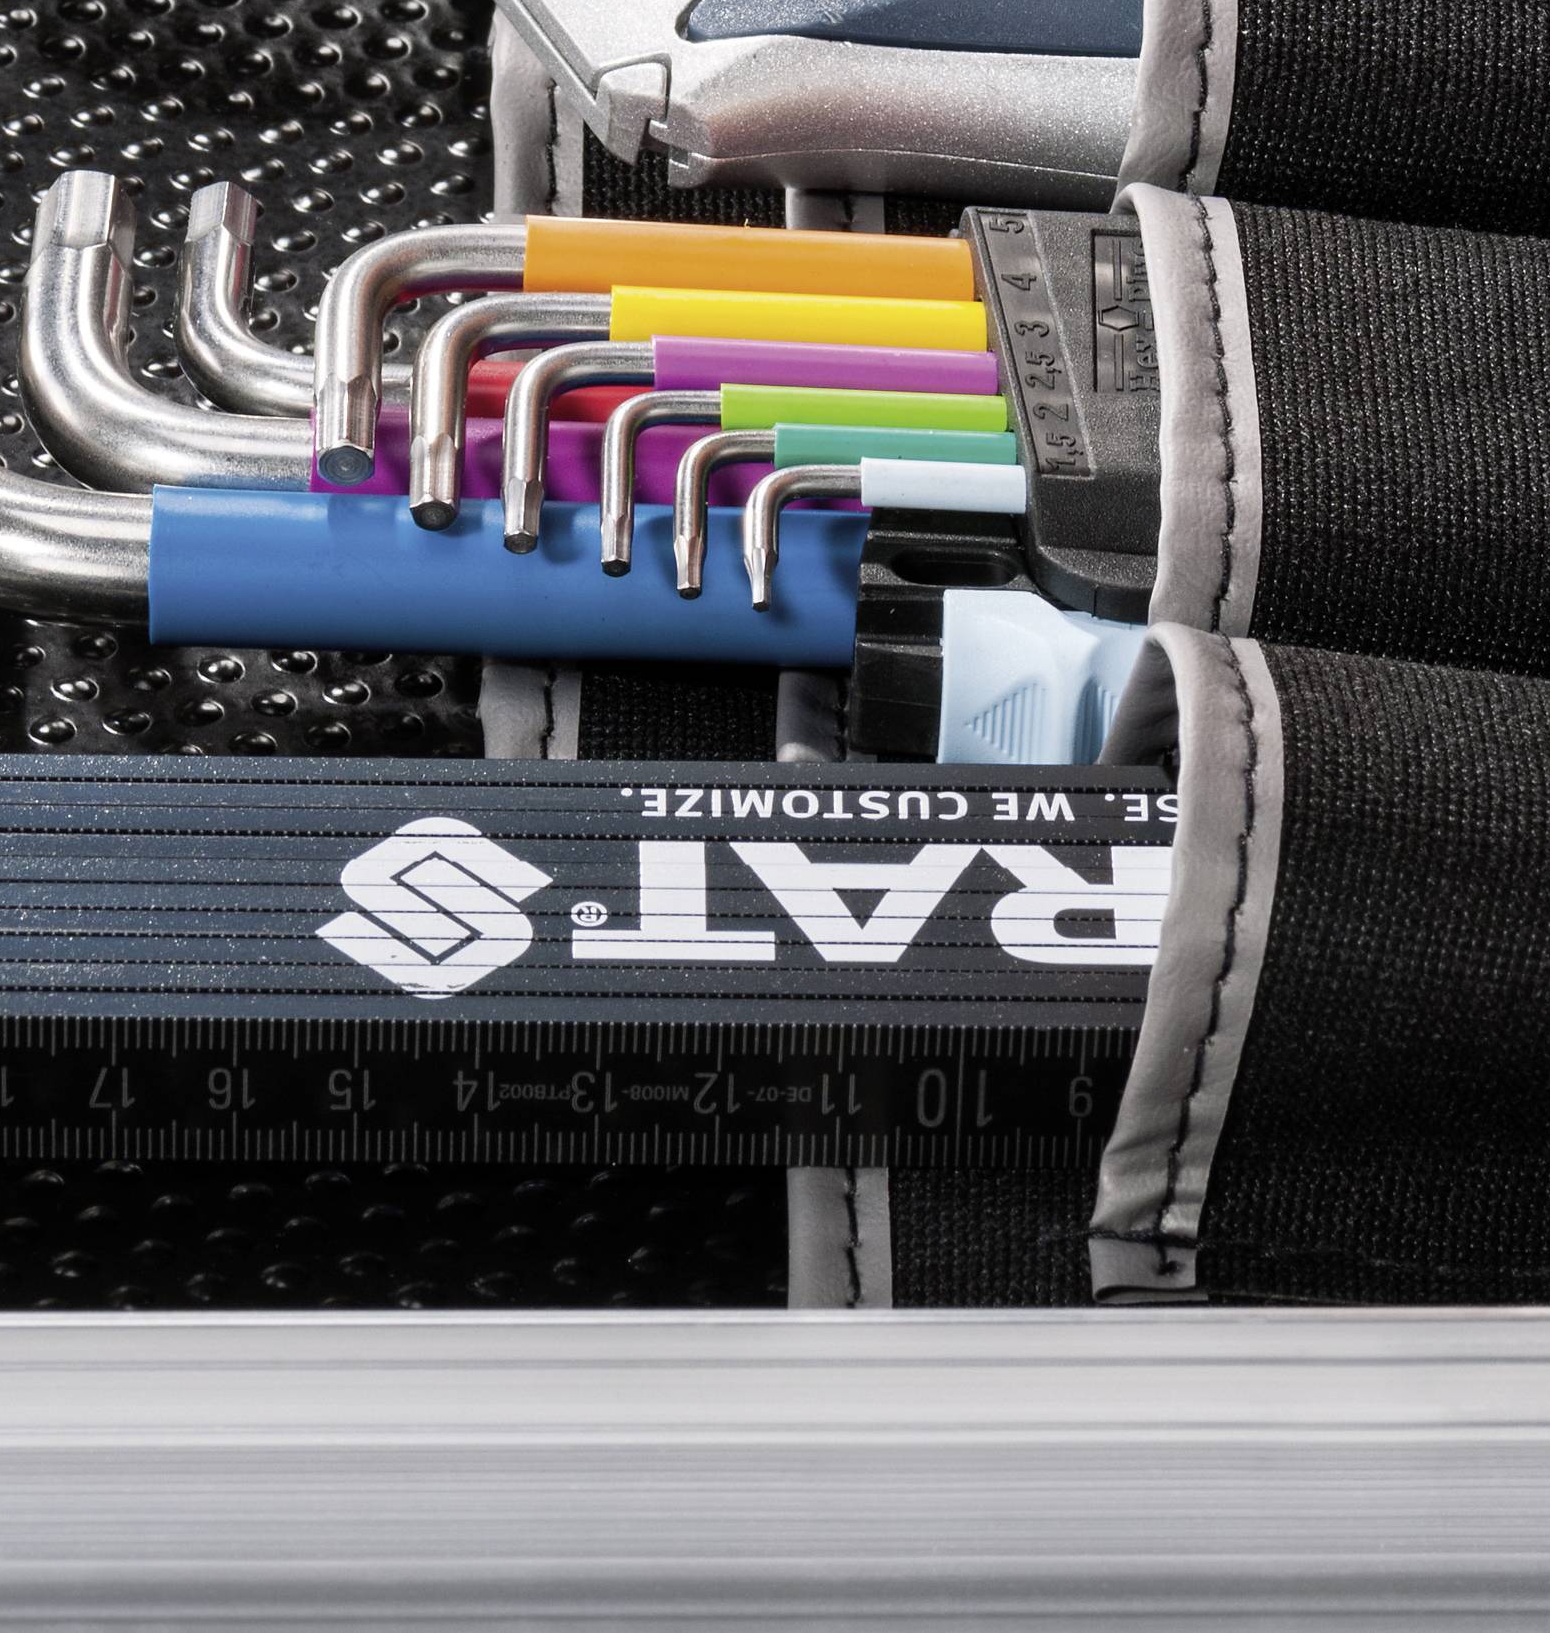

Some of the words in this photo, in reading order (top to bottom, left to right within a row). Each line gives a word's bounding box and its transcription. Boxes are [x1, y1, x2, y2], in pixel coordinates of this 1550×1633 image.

[989, 217, 1024, 234] 5
[1001, 273, 1037, 291] 4
[1014, 320, 1049, 338] 3
[1025, 351, 1062, 391] 2,5
[1033, 402, 1069, 421] 2
[620, 787, 969, 821] CUSTOMIZE.
[991, 792, 1076, 822] WE
[89, 1067, 135, 1108] 17
[208, 1068, 255, 1109] 16
[329, 1069, 376, 1111] 15
[453, 1070, 501, 1112] 14
[572, 1071, 618, 1113] 13
[694, 1072, 740, 1114] 12
[821, 1073, 862, 1115] 11
[919, 1070, 993, 1127] 10
[1069, 1076, 1093, 1117] 9
